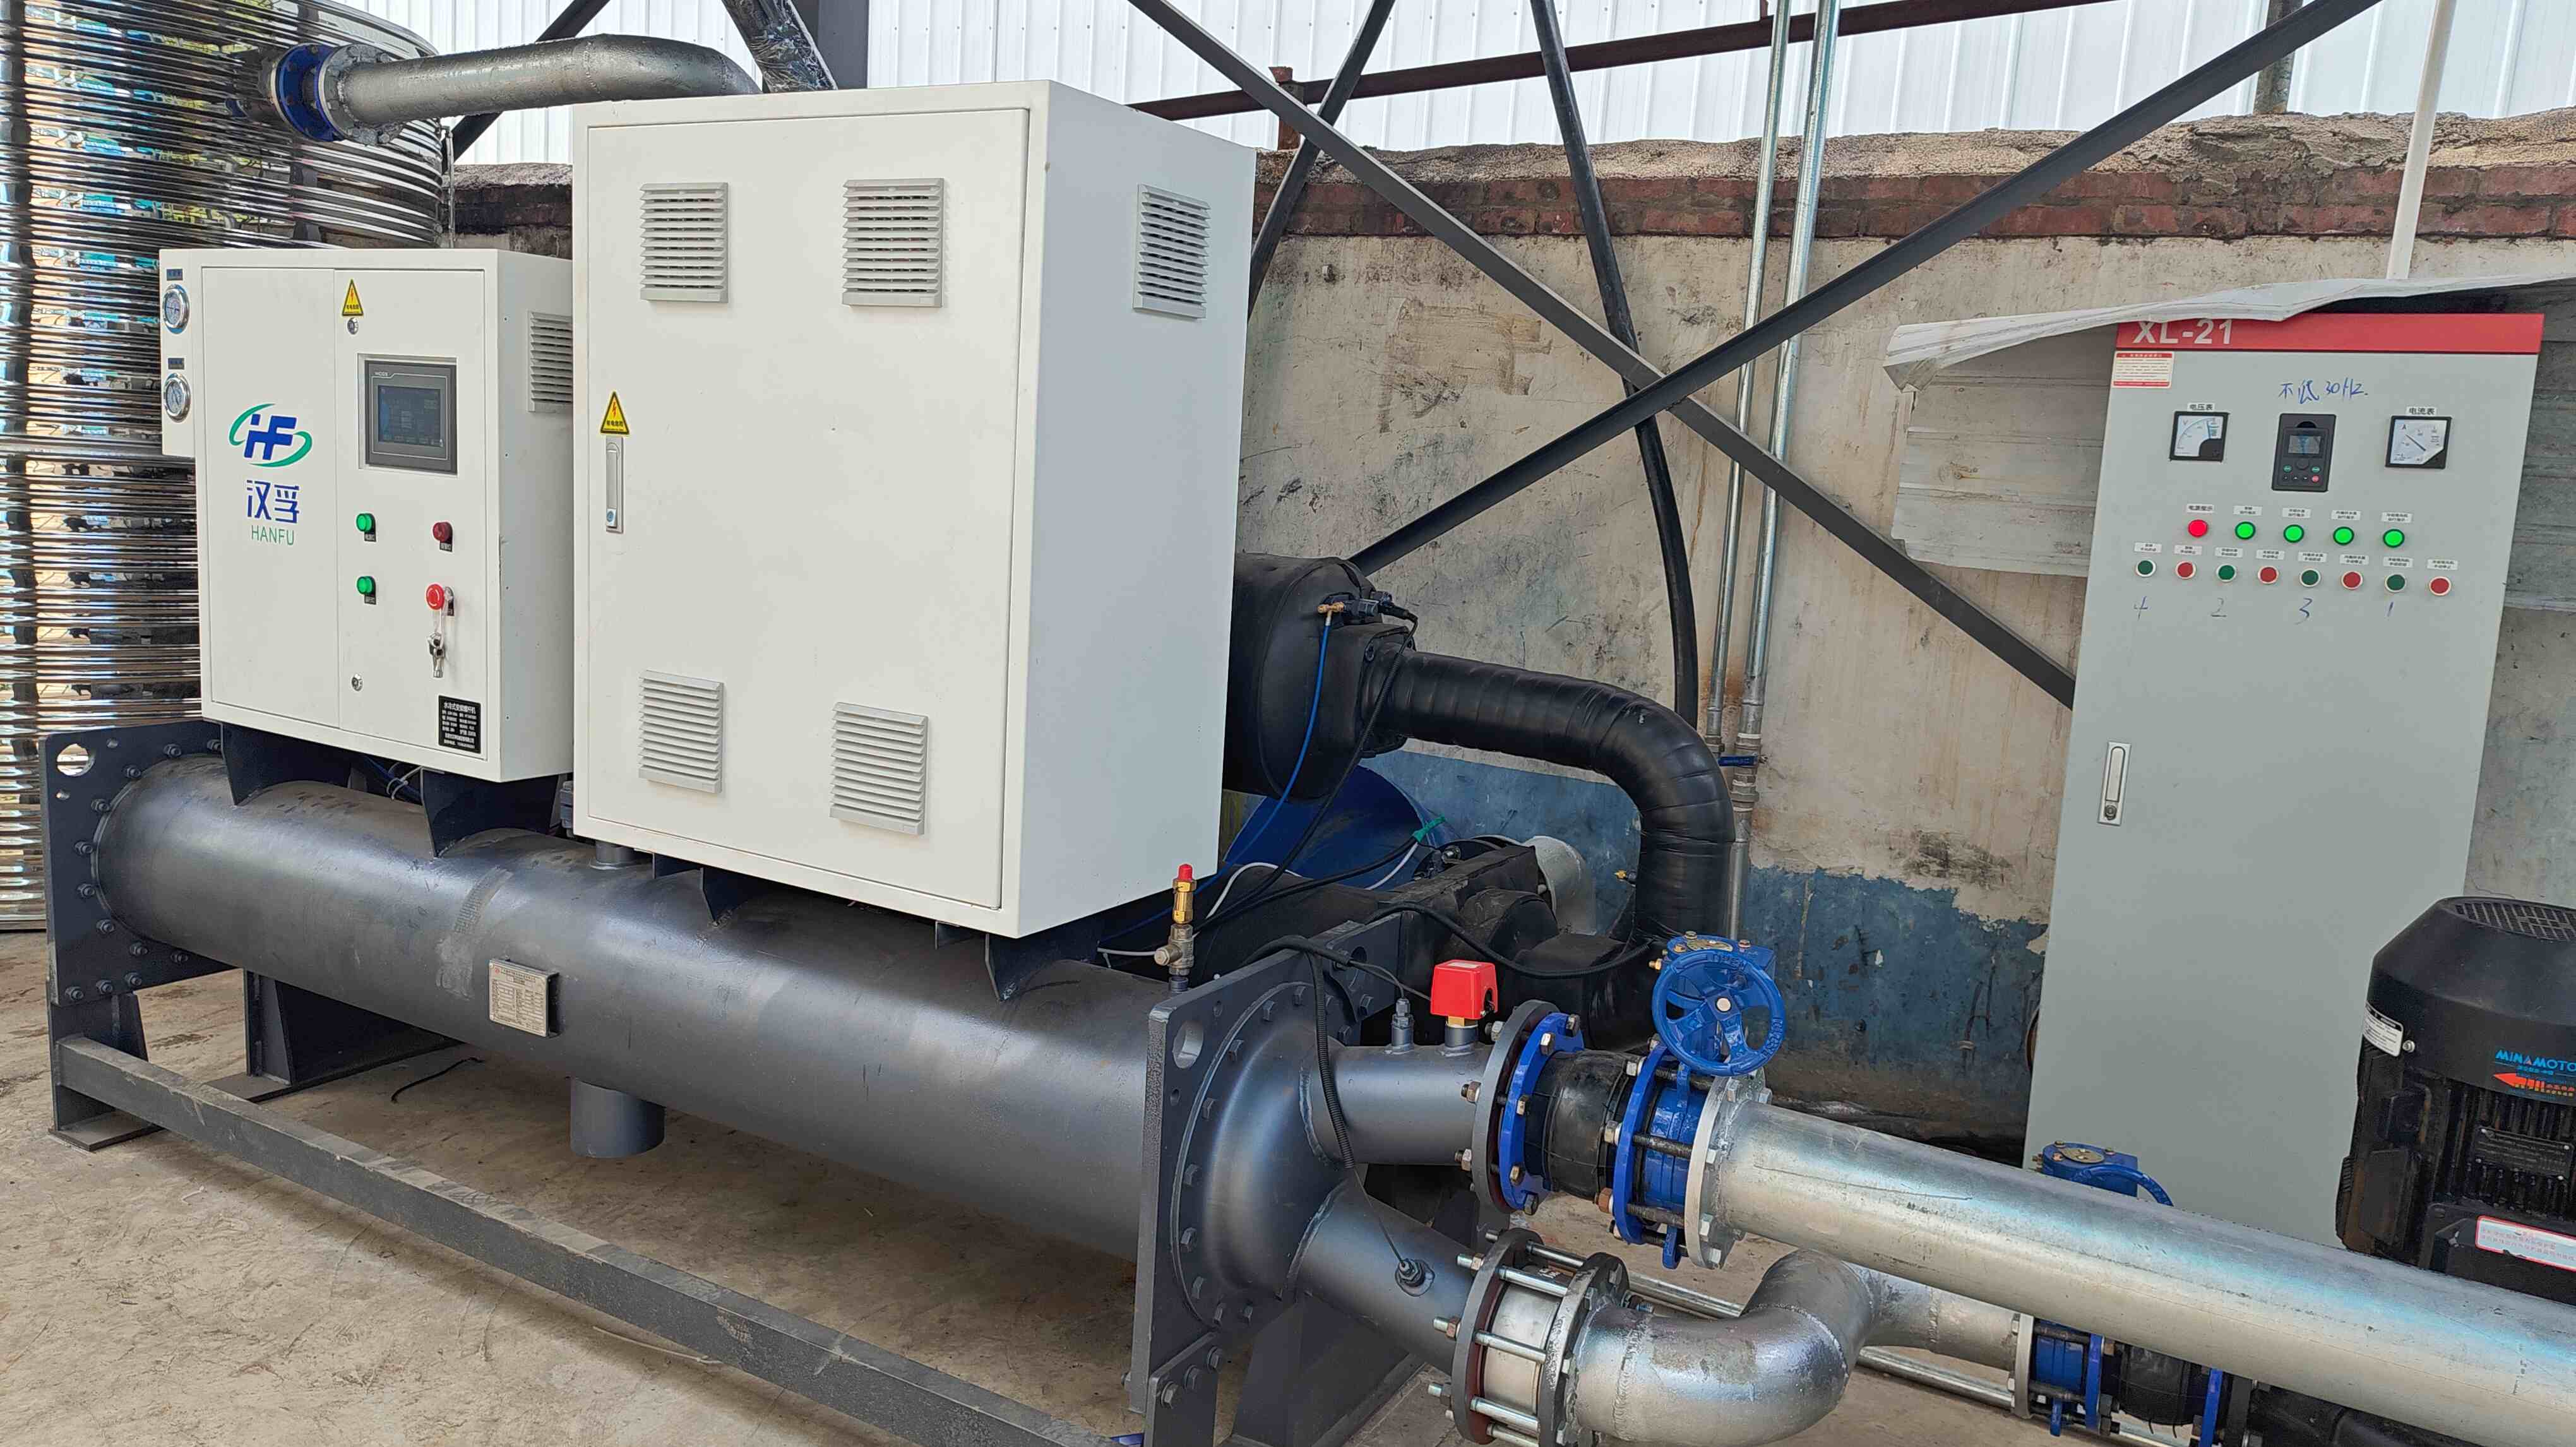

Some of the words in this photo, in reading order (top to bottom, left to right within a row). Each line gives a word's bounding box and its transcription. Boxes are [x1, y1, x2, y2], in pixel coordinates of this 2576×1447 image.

[2132, 319, 2233, 345] XL-21
[246, 480, 299, 523] 汉孚
[251, 525, 295, 545] HANFU
[2211, 597, 2227, 617] 2
[2295, 597, 2313, 625] 3
